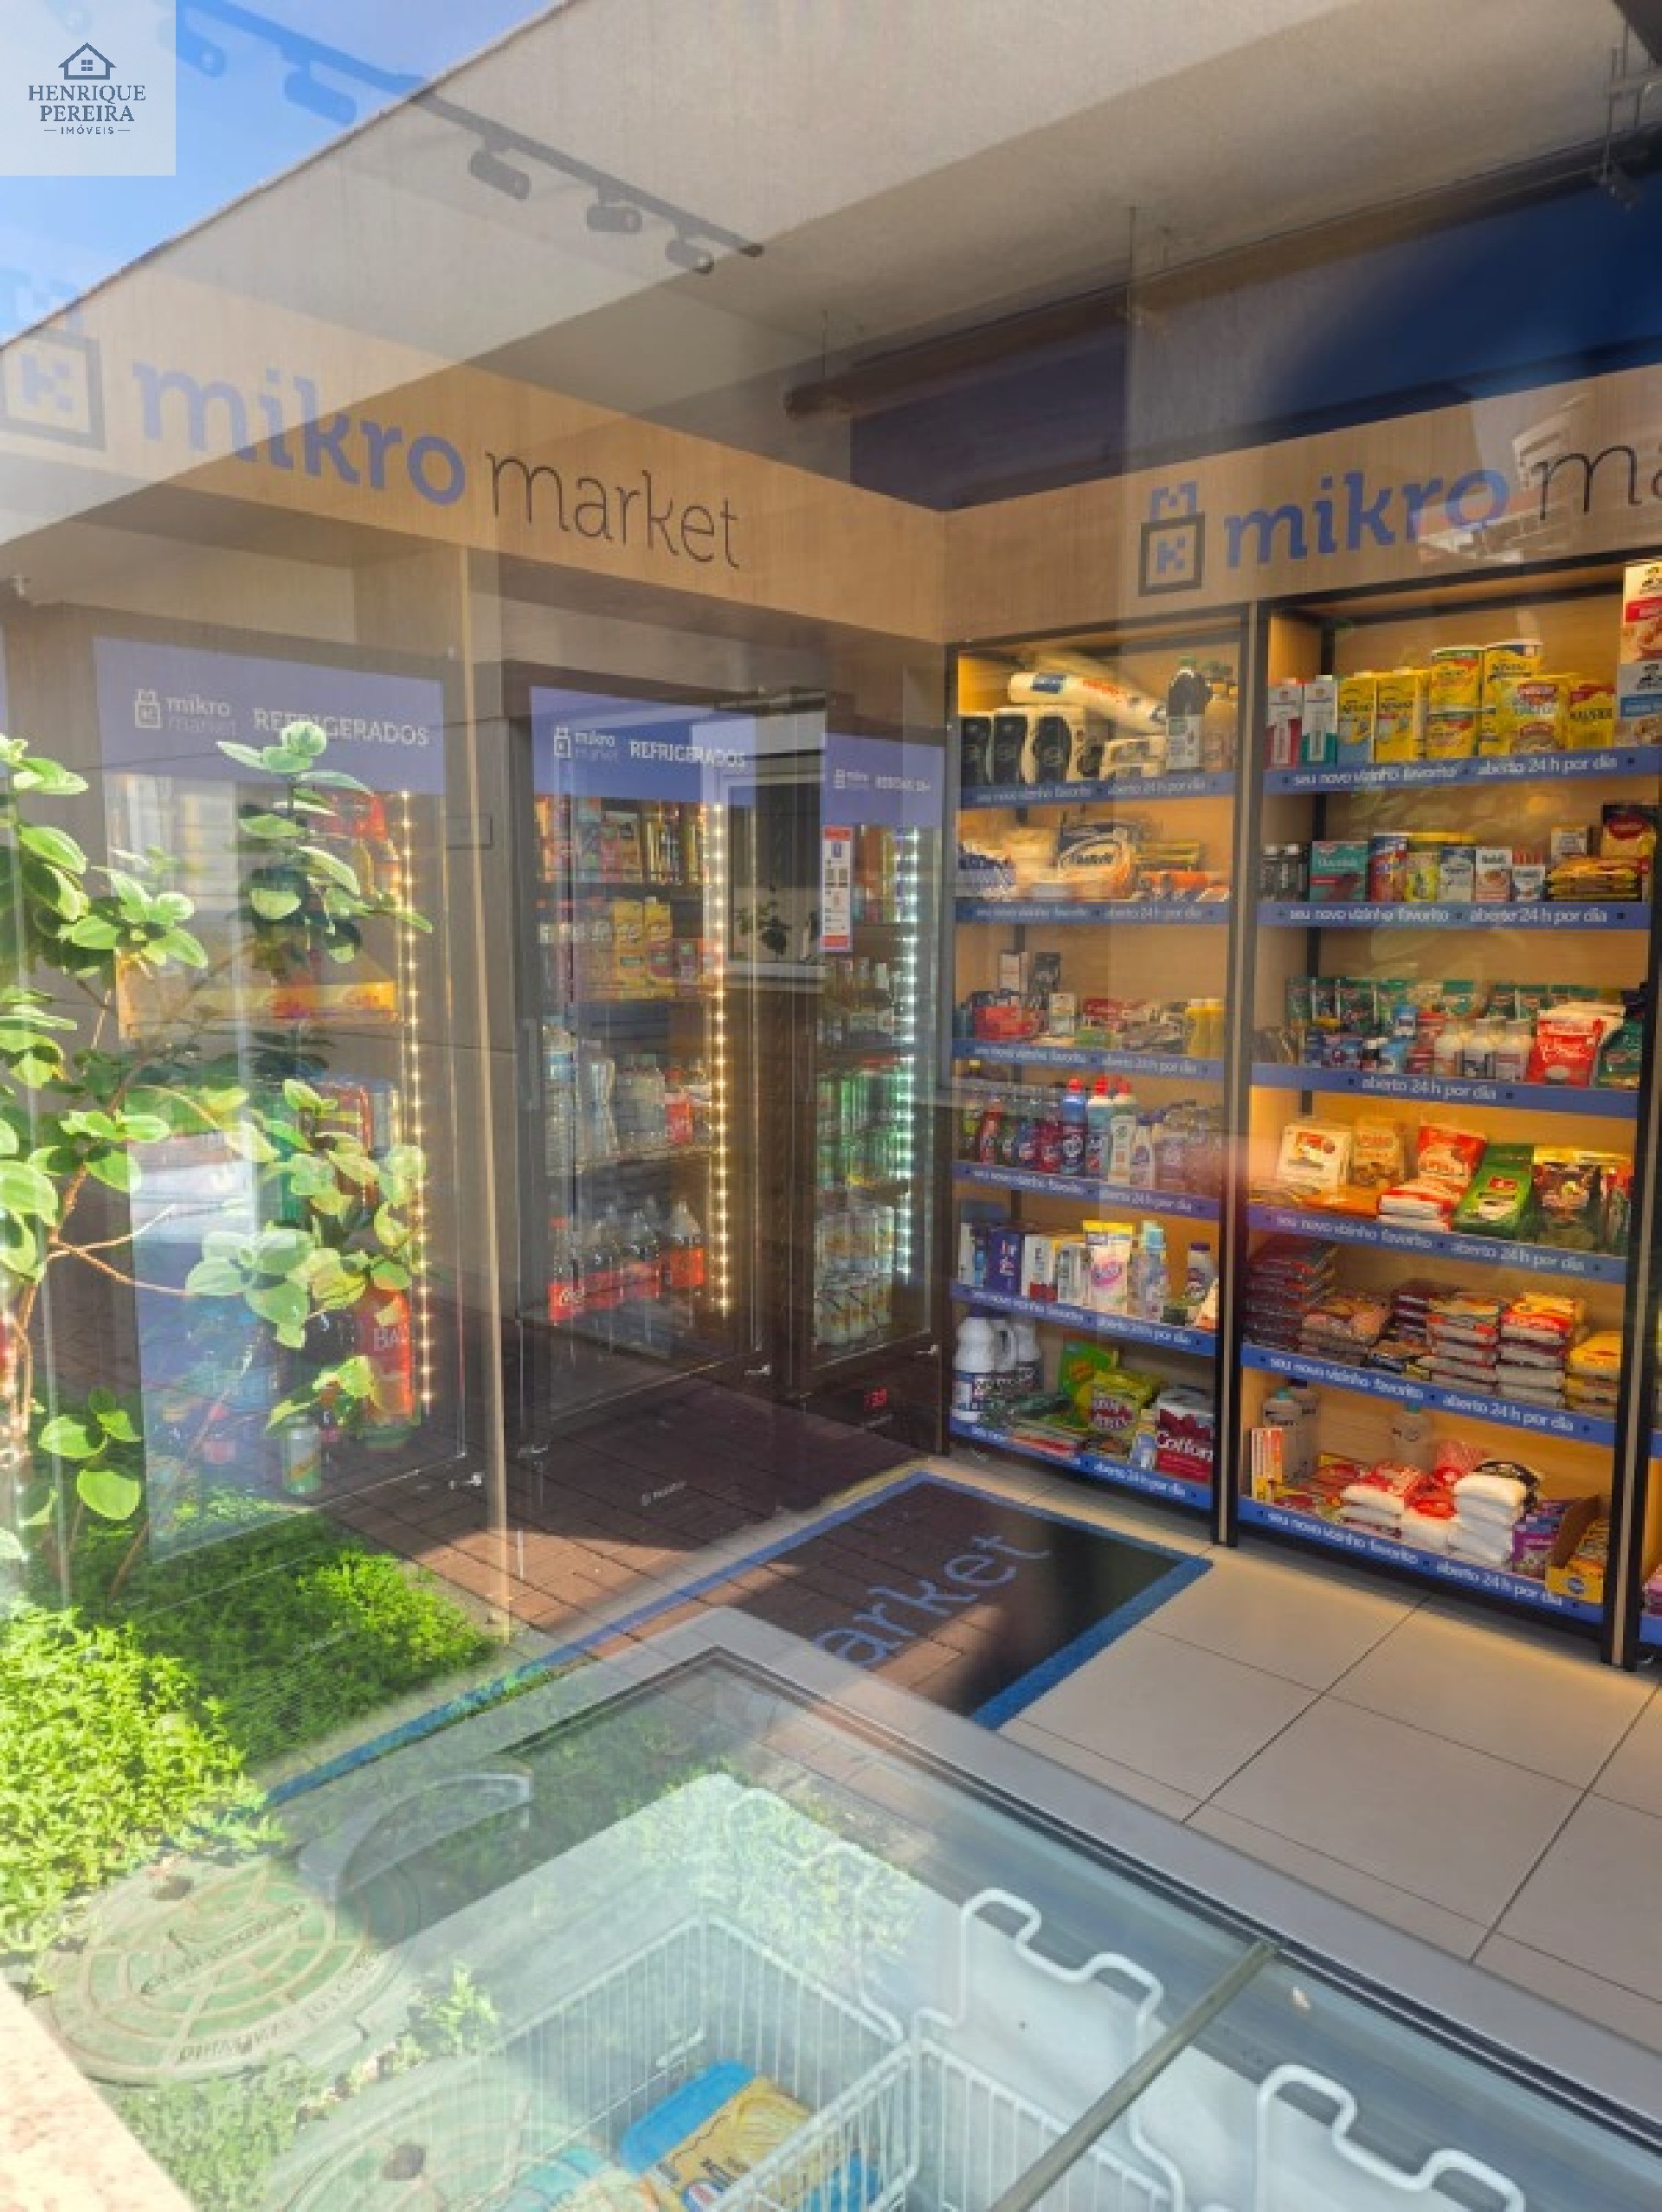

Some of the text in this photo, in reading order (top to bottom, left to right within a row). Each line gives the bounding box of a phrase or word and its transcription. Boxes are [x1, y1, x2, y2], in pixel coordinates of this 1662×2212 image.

[132, 362, 741, 569] mikro market
[1223, 468, 1511, 570] mikro
[165, 695, 232, 718] mikro
[1562, 758, 1589, 773] por
[1593, 755, 1618, 768] dia
[1294, 774, 1317, 785] seu
[1318, 773, 1351, 784] novo
[1290, 910, 1311, 920] seu
[1312, 910, 1348, 920] novo
[1396, 907, 1450, 921] favorito
[1554, 910, 1581, 924] por
[1582, 908, 1608, 923] dia
[1362, 1076, 1409, 1092] aberto
[1444, 1083, 1470, 1099] por
[1472, 1083, 1498, 1100] dia
[1534, 1254, 1559, 1270] por
[1269, 1356, 1292, 1372] seu
[1325, 1366, 1369, 1389] vizinho
[1522, 1409, 1548, 1428] por
[1550, 1411, 1575, 1433] dia
[1513, 1582, 1539, 1599] por
[812, 1534, 1053, 1671] arket
